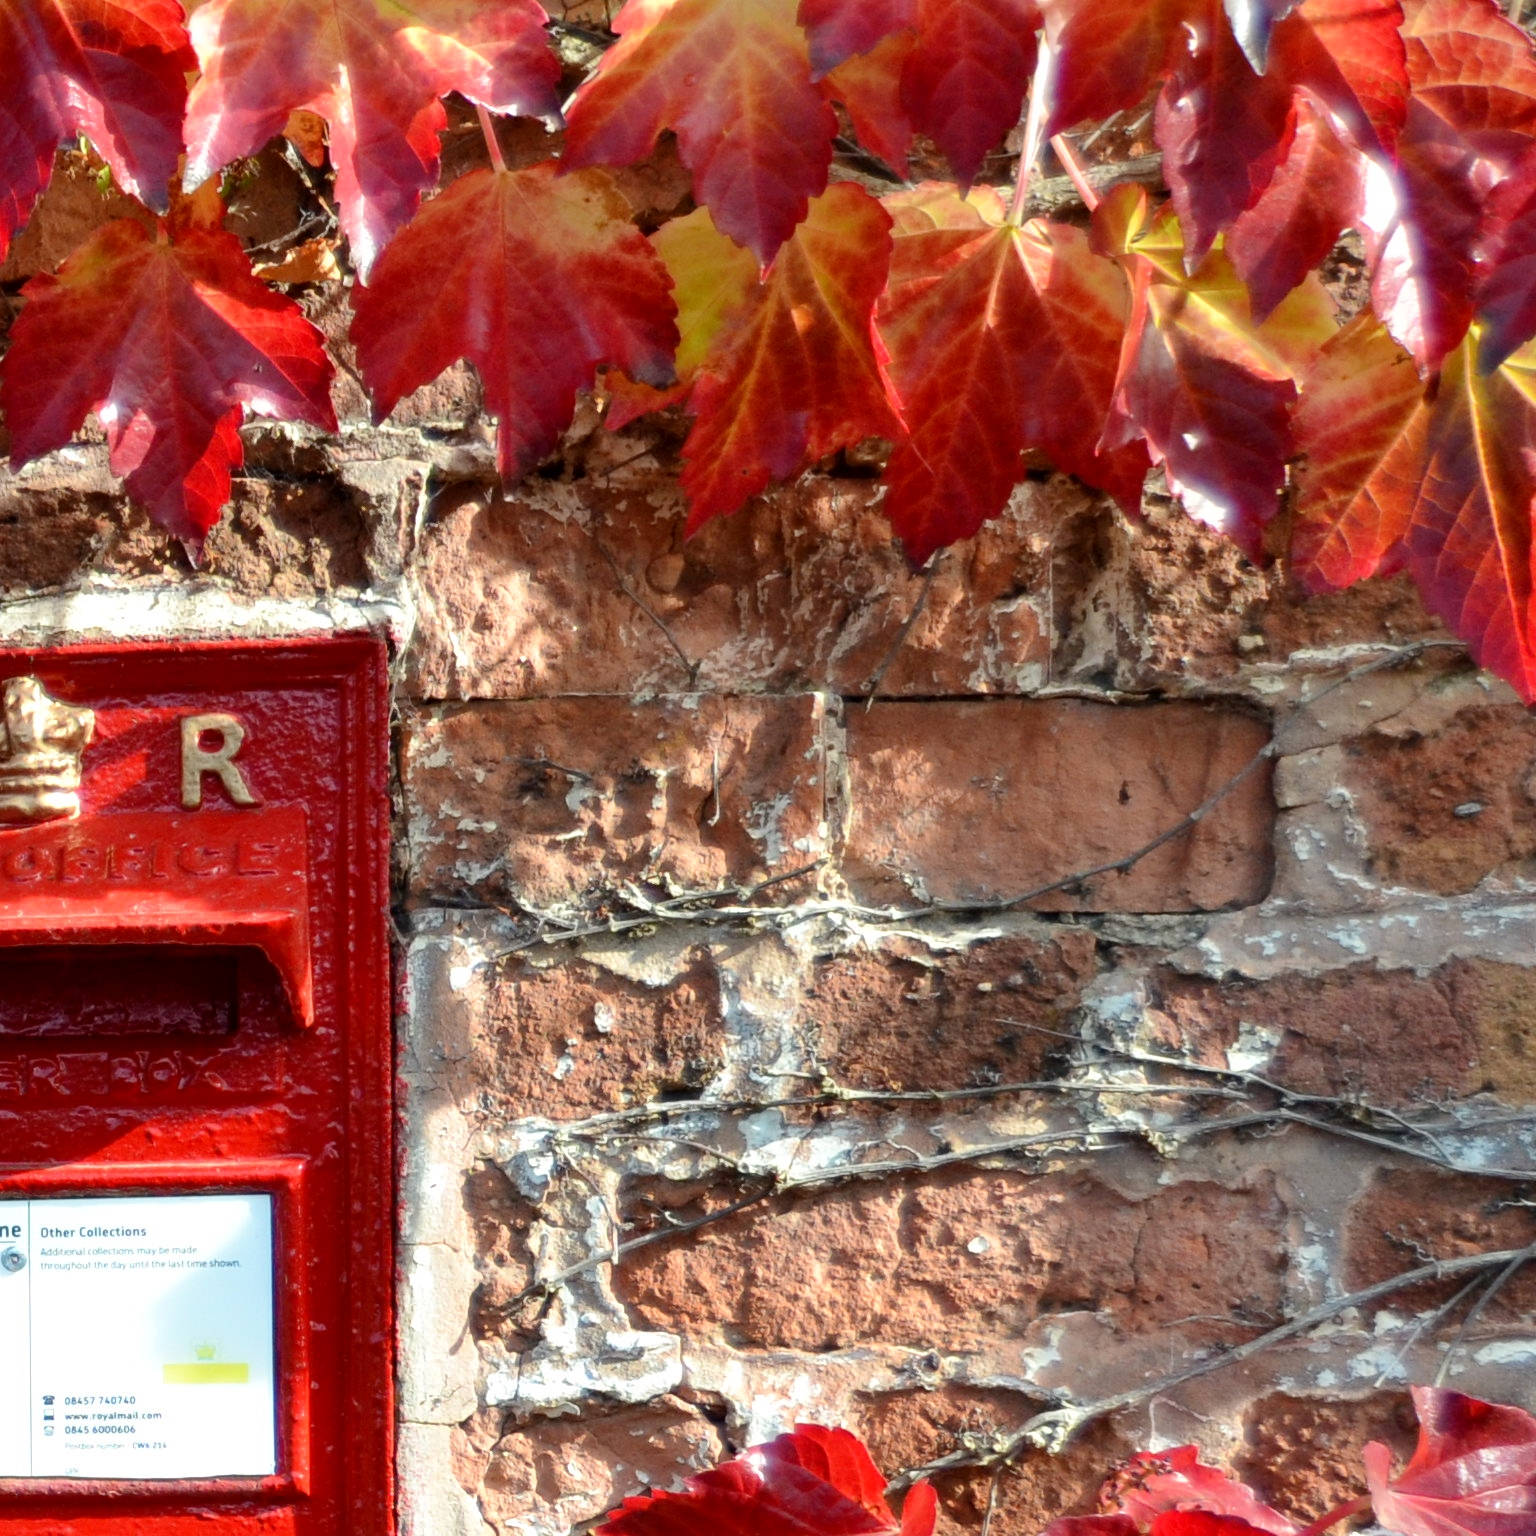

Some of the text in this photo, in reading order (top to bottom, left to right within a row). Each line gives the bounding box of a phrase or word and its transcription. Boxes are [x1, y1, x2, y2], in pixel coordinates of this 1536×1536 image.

[179, 714, 262, 811] R
[0, 842, 281, 885] OFFICE
[40, 1225, 147, 1239] Other Collections
[40, 1245, 197, 1257] Additional collections may be made
[40, 1261, 91, 1271] throughout
[94, 1261, 108, 1270] the
[111, 1260, 126, 1270] day
[152, 1259, 166, 1268] the
[168, 1259, 184, 1268] last
[187, 1258, 207, 1268] time
[64, 1395, 136, 1406] 08457 740740
[65, 1411, 162, 1421] www.royalmail.com
[65, 1425, 136, 1435] 0845 6000606
